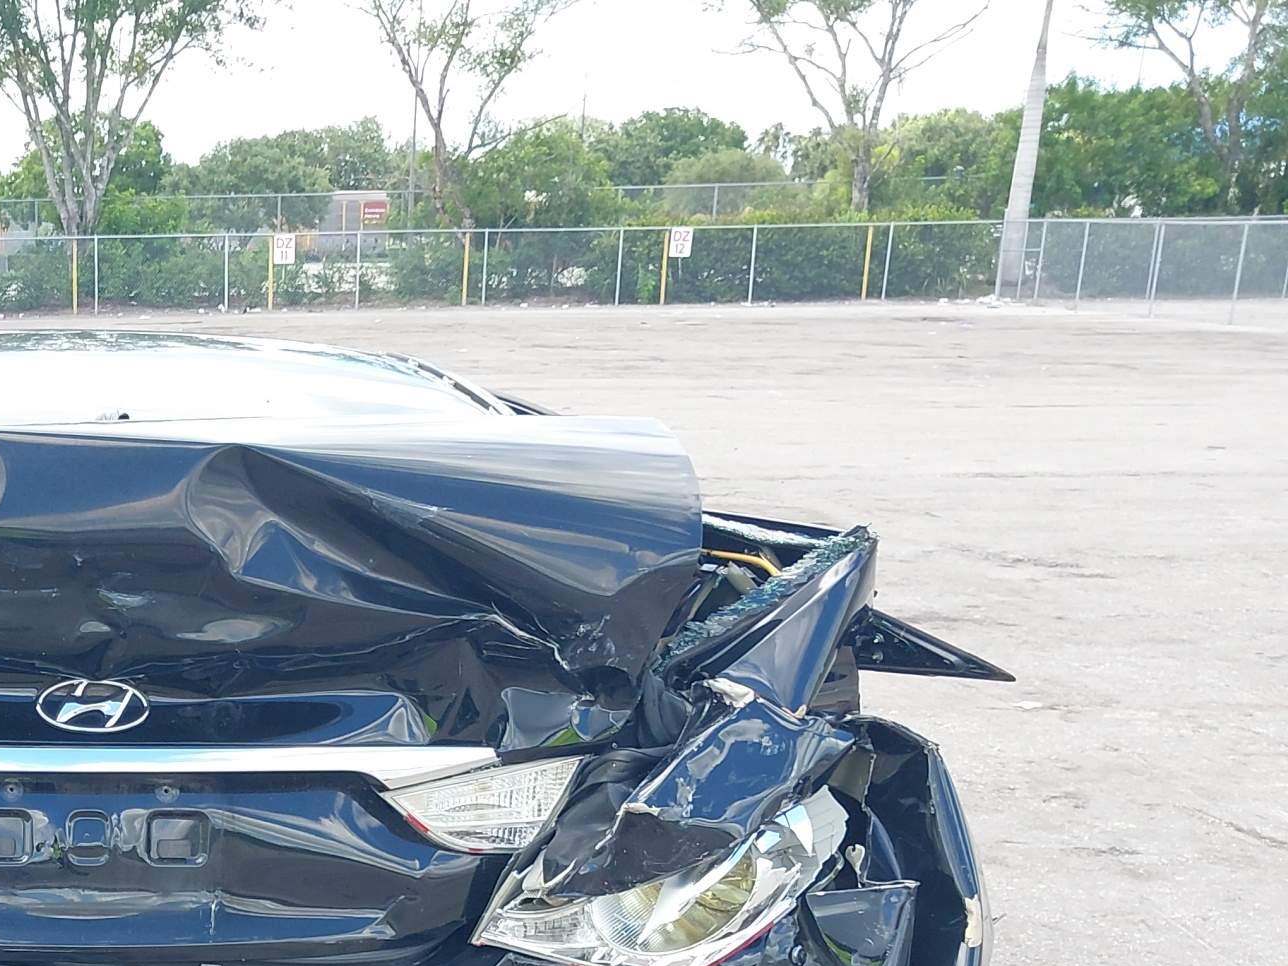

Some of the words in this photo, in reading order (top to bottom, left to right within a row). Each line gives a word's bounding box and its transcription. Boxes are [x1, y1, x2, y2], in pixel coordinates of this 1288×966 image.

[674, 230, 690, 242] DZ
[276, 237, 293, 249] DZ
[675, 243, 685, 255] 12
[280, 250, 288, 262] 11
